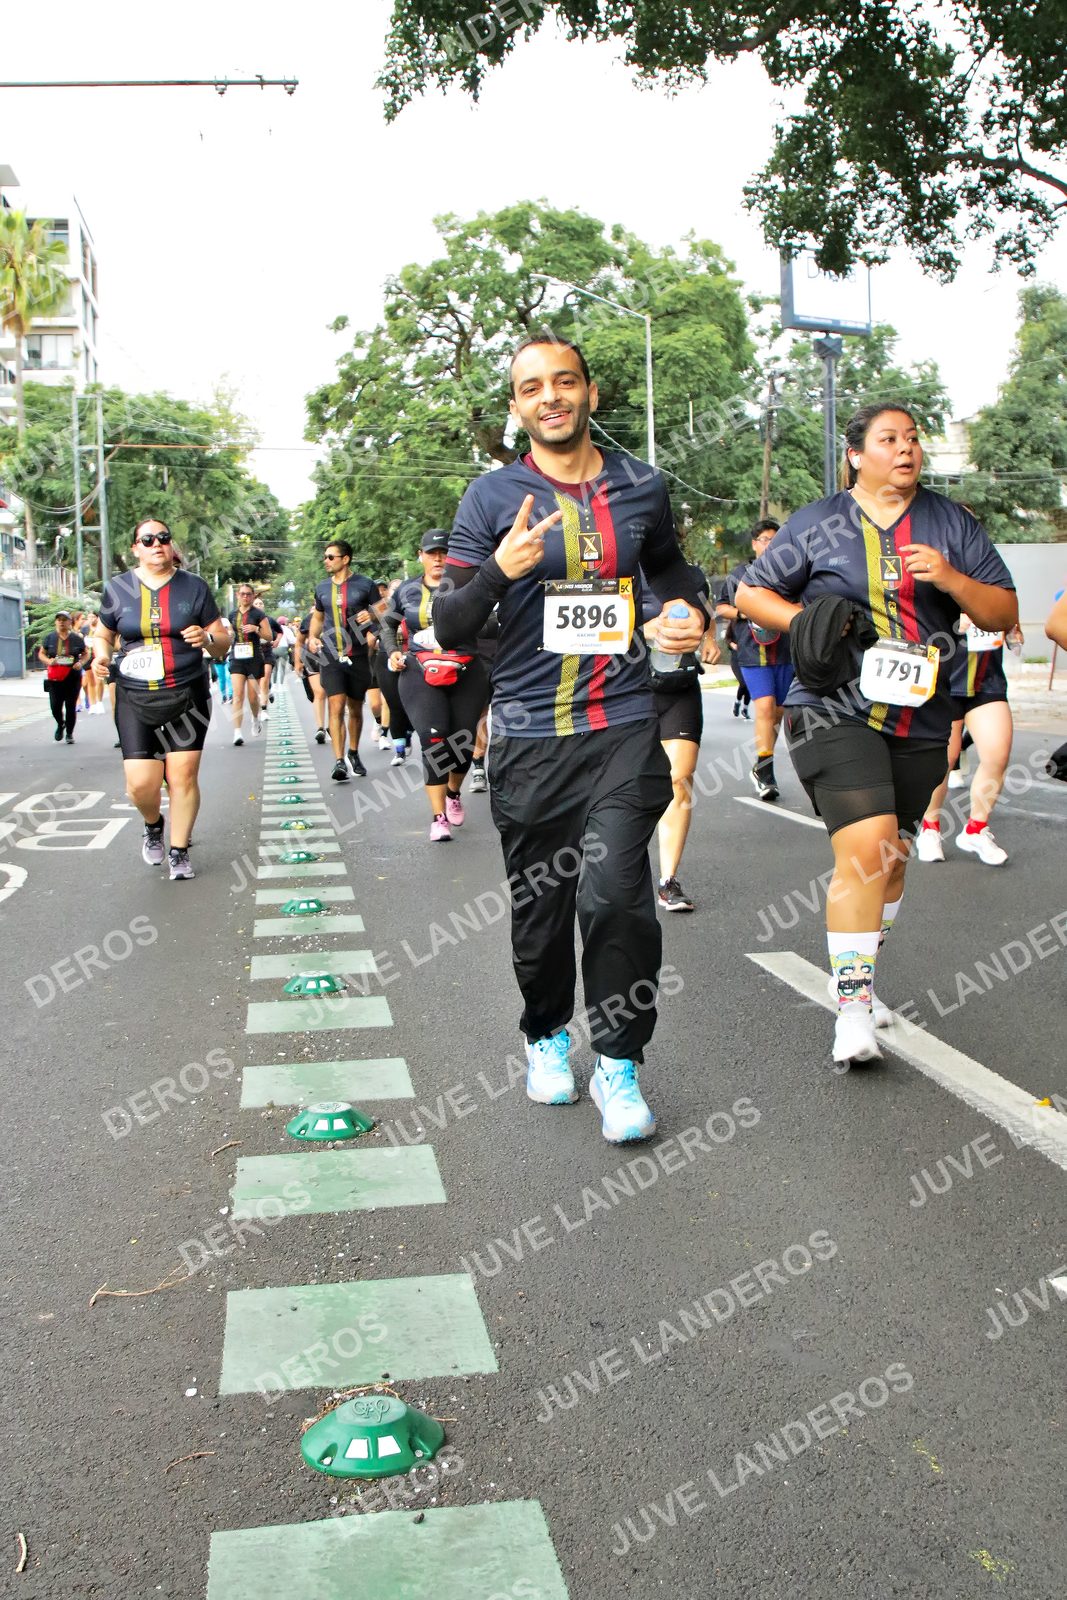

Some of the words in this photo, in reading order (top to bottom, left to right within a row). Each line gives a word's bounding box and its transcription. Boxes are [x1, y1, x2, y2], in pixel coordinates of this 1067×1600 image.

[620, 584, 630, 593] 5K
[556, 604, 617, 629] 5896
[875, 657, 922, 684] 1791
